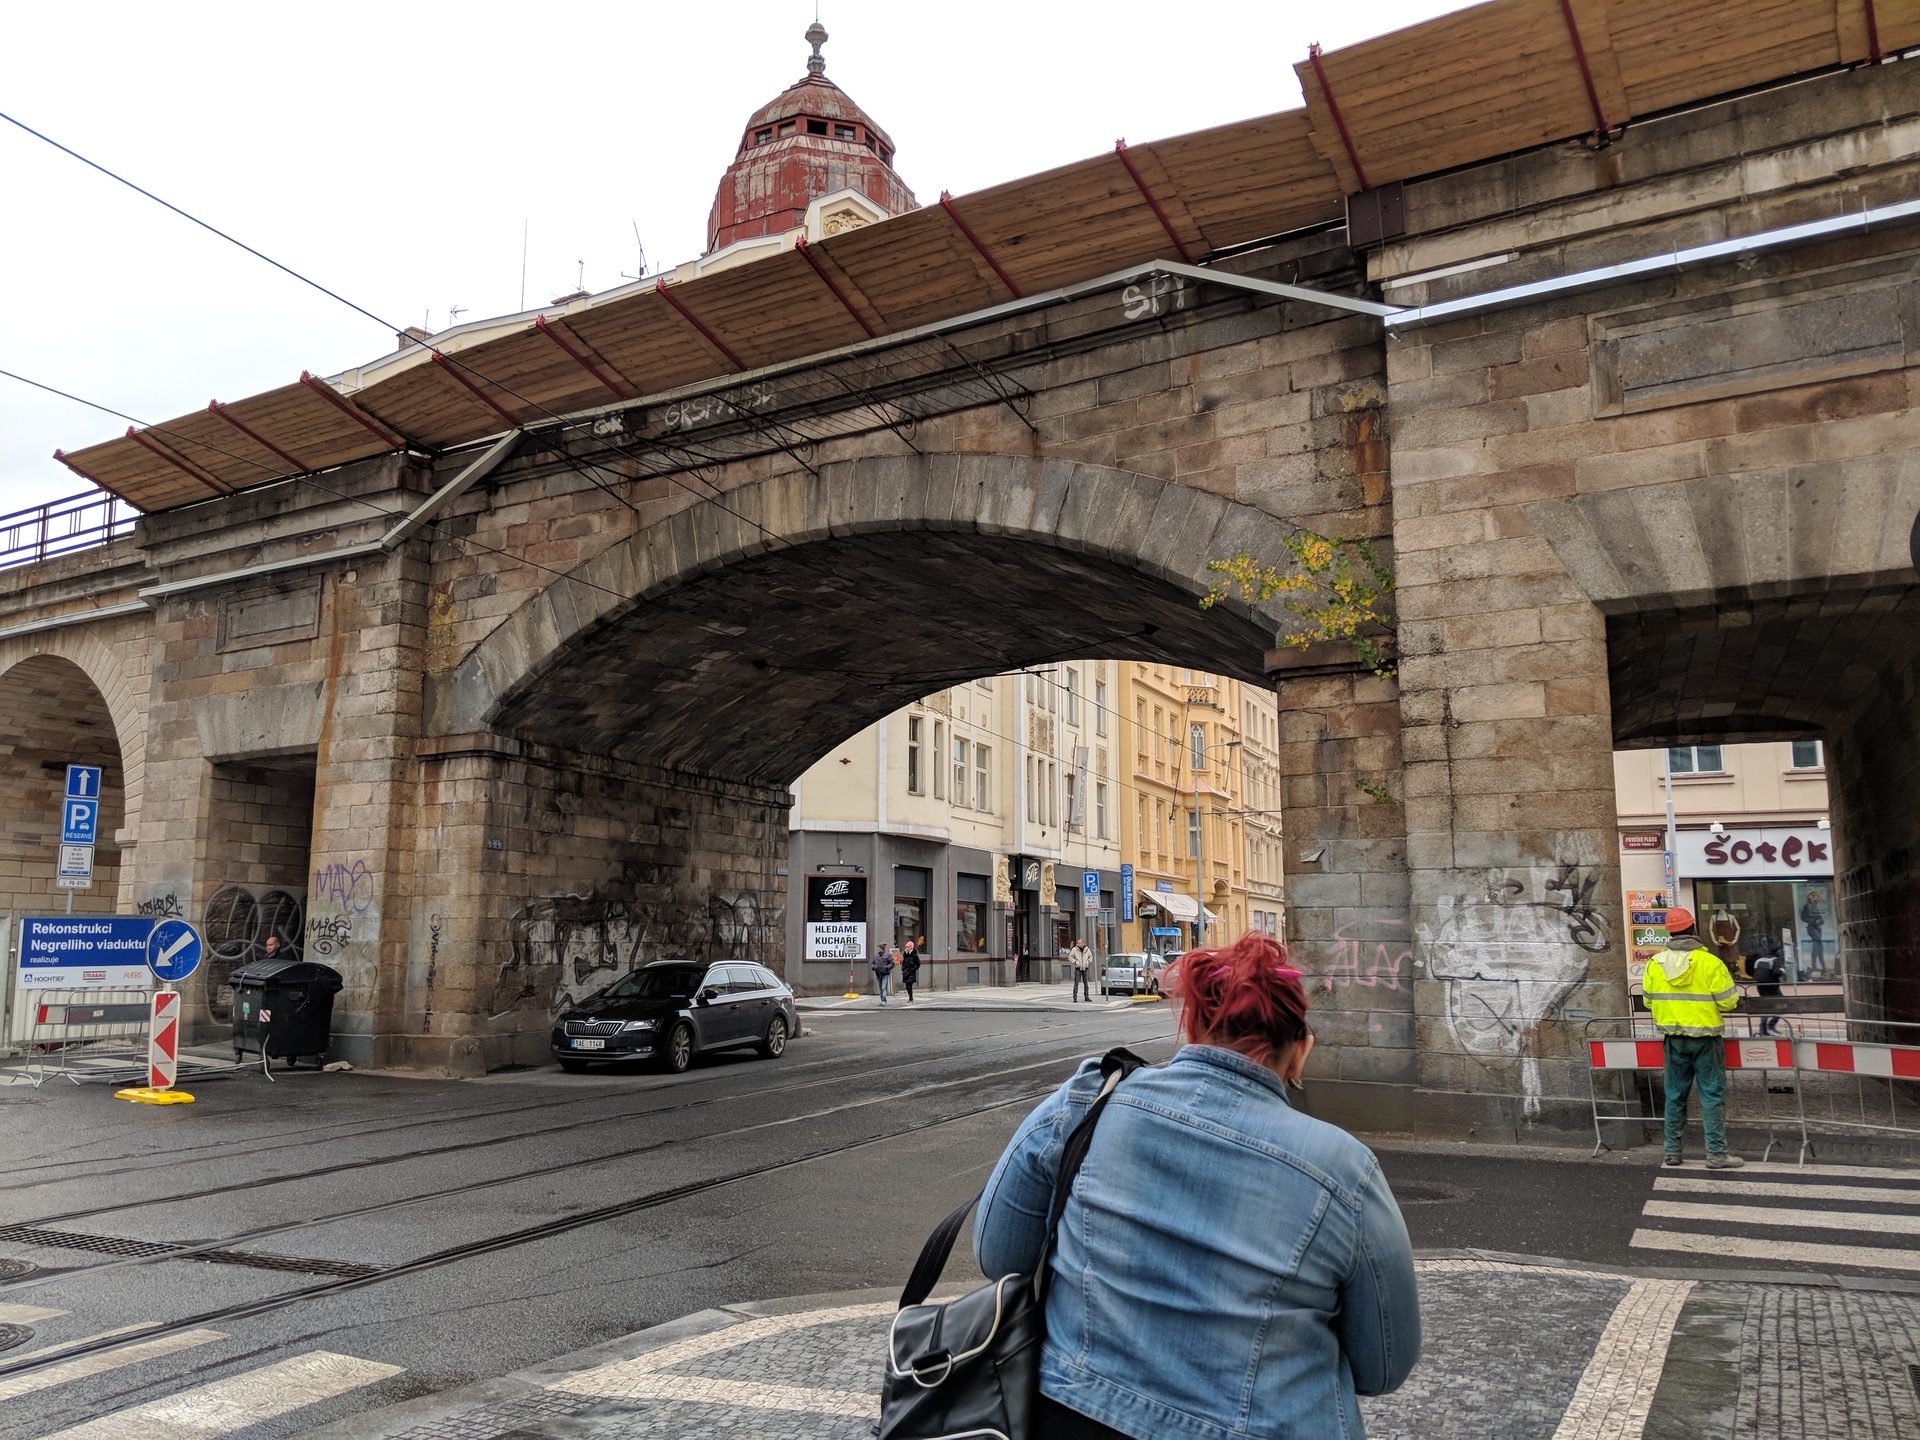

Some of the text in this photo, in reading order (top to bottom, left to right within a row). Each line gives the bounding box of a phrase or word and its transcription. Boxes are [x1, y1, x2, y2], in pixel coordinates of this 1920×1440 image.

[71, 804, 90, 829] P
[32, 923, 112, 934] Rekonstrukci
[815, 923, 858, 933] HLEDÁME
[815, 935, 858, 944] KUCHAŘE
[31, 939, 146, 953] Negrelliho viaduktu
[30, 956, 59, 964] realizuje
